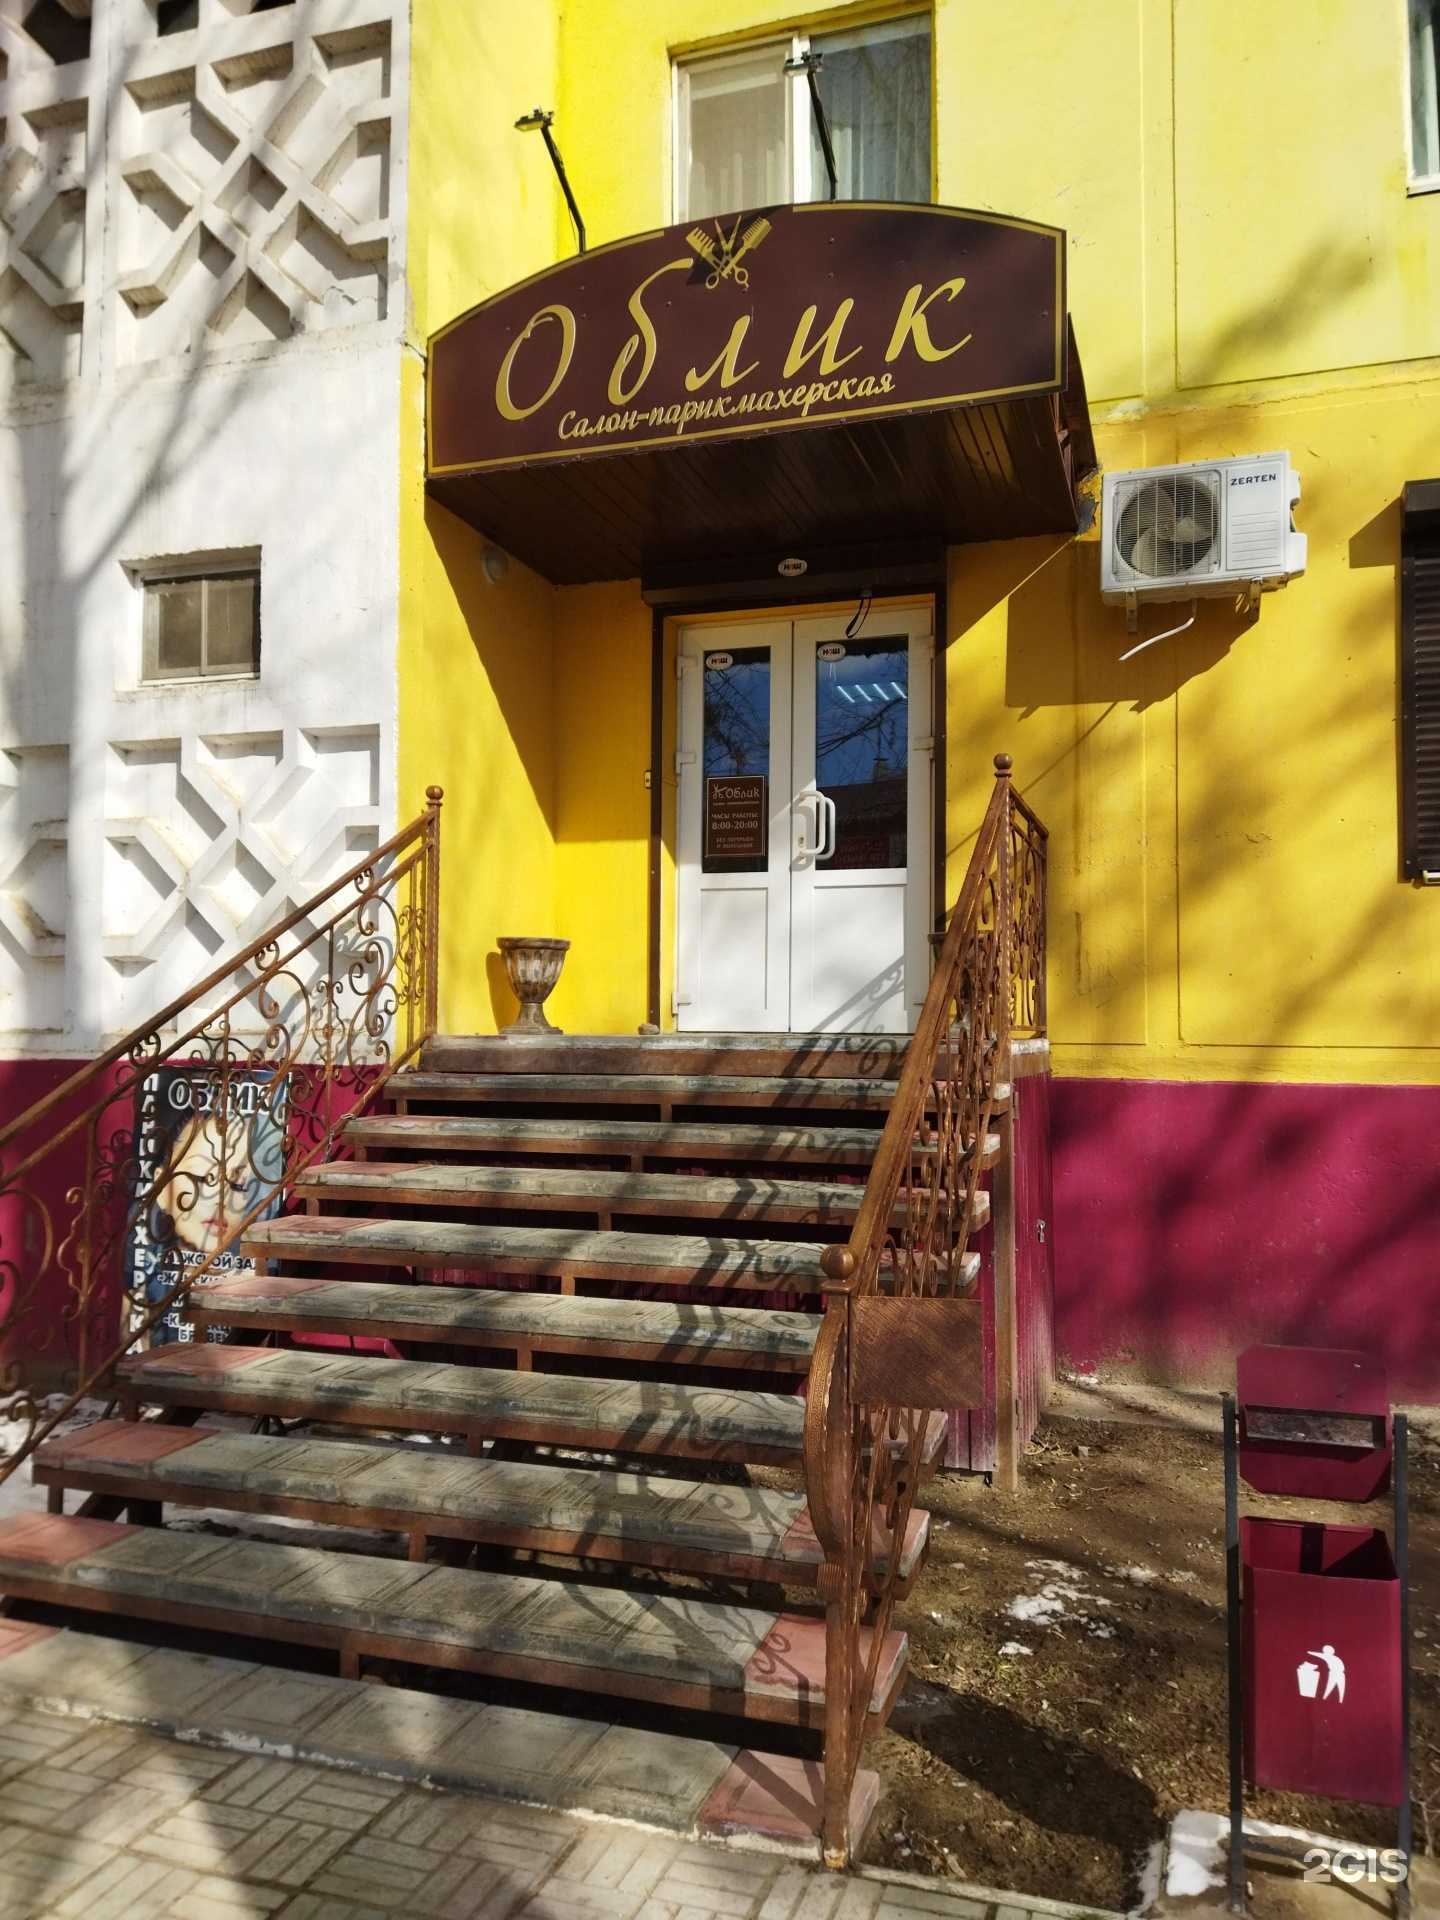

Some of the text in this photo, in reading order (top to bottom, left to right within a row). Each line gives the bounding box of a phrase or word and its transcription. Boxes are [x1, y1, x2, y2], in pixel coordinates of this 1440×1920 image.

[495, 257, 972, 420] Облик
[557, 372, 895, 441] Салон-парикмахерская
[1230, 473, 1277, 486] ZERTEN
